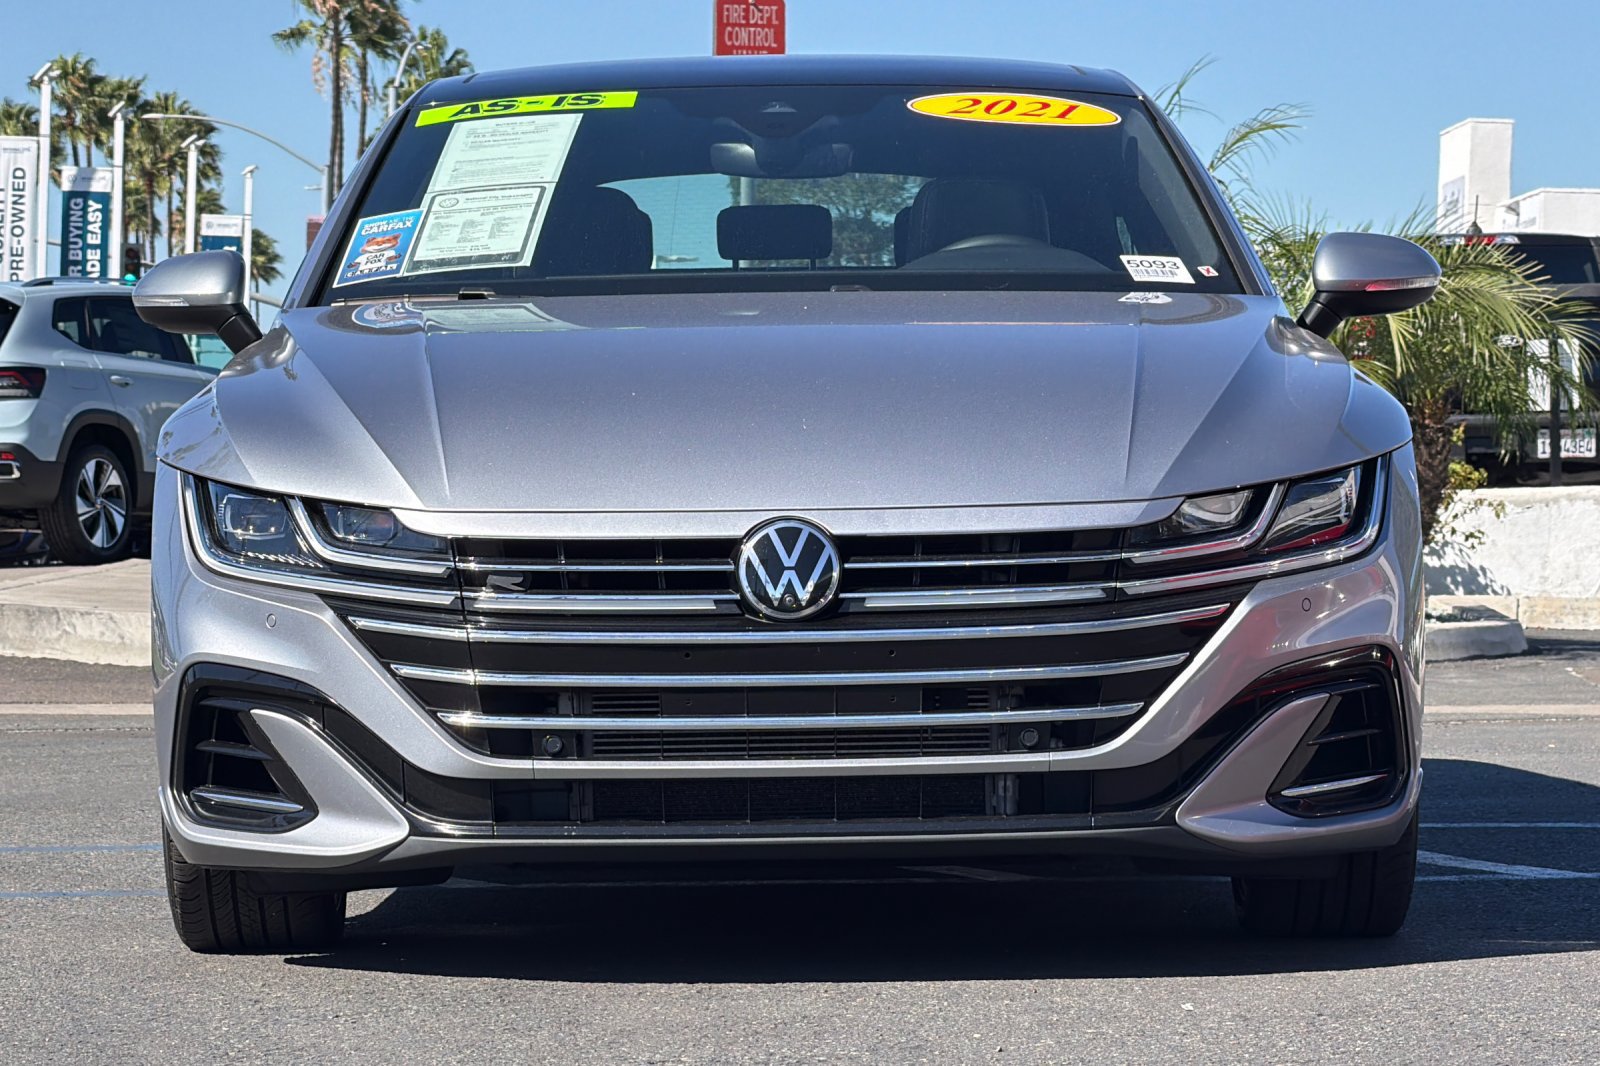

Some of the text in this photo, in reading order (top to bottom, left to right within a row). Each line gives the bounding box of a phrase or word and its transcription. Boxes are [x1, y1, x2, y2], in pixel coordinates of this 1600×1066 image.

[723, 4, 747, 24] FIRE
[724, 26, 778, 48] CONTROL
[947, 98, 1080, 120] 2021
[10, 167, 26, 282] PRE-OWNED
[68, 197, 84, 260] BUYING
[87, 199, 103, 245] EASY
[361, 220, 413, 235] CARFAX
[1126, 259, 1180, 269] 5093
